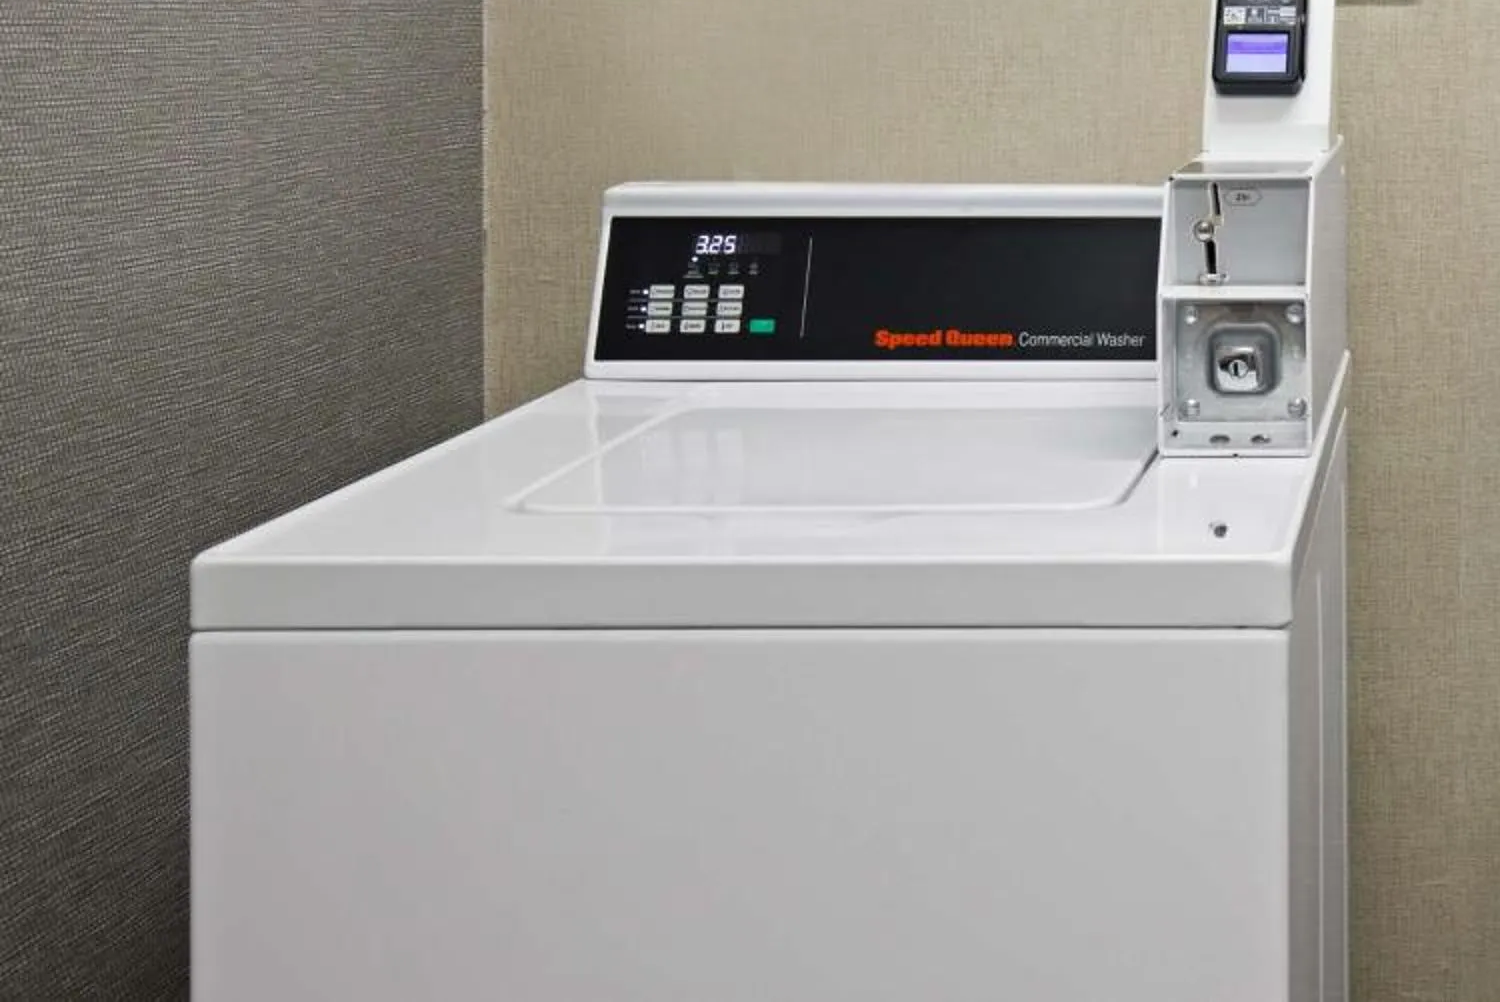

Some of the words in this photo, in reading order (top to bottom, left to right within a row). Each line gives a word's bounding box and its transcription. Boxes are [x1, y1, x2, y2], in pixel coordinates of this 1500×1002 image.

[875, 329, 942, 349] Speed
[946, 329, 1014, 347] Queen
[1018, 331, 1094, 347] Commercial
[1095, 331, 1145, 347] Washer
